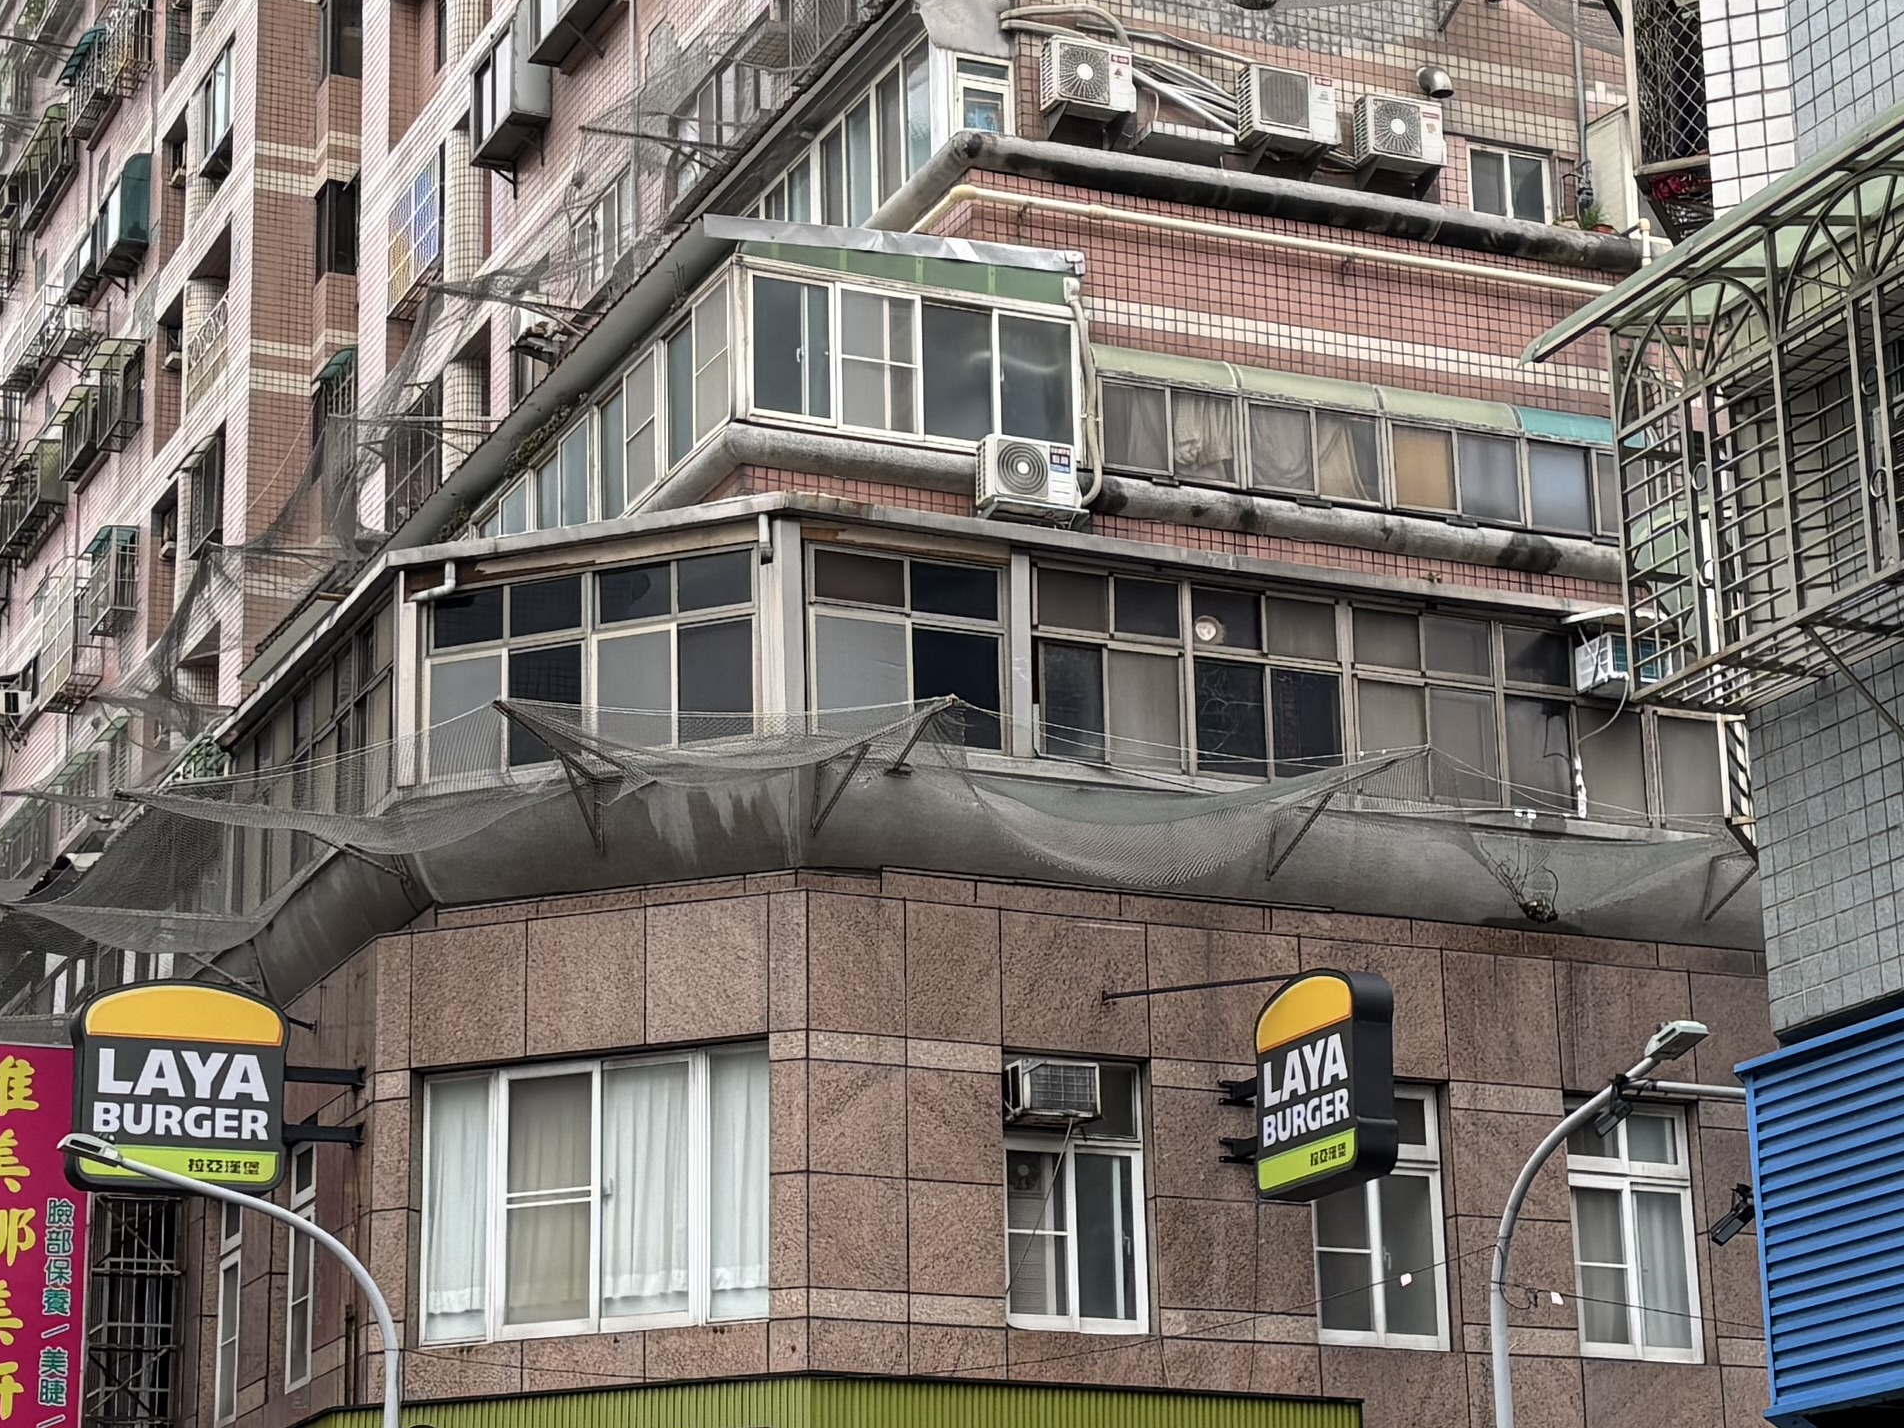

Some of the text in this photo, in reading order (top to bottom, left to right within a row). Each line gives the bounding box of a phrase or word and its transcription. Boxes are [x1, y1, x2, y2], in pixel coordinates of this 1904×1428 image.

[98, 1048, 270, 1102] LAYA
[1264, 1033, 1348, 1108] LAYA
[93, 1101, 269, 1140] BURGER
[1263, 1088, 1350, 1147] BURGER
